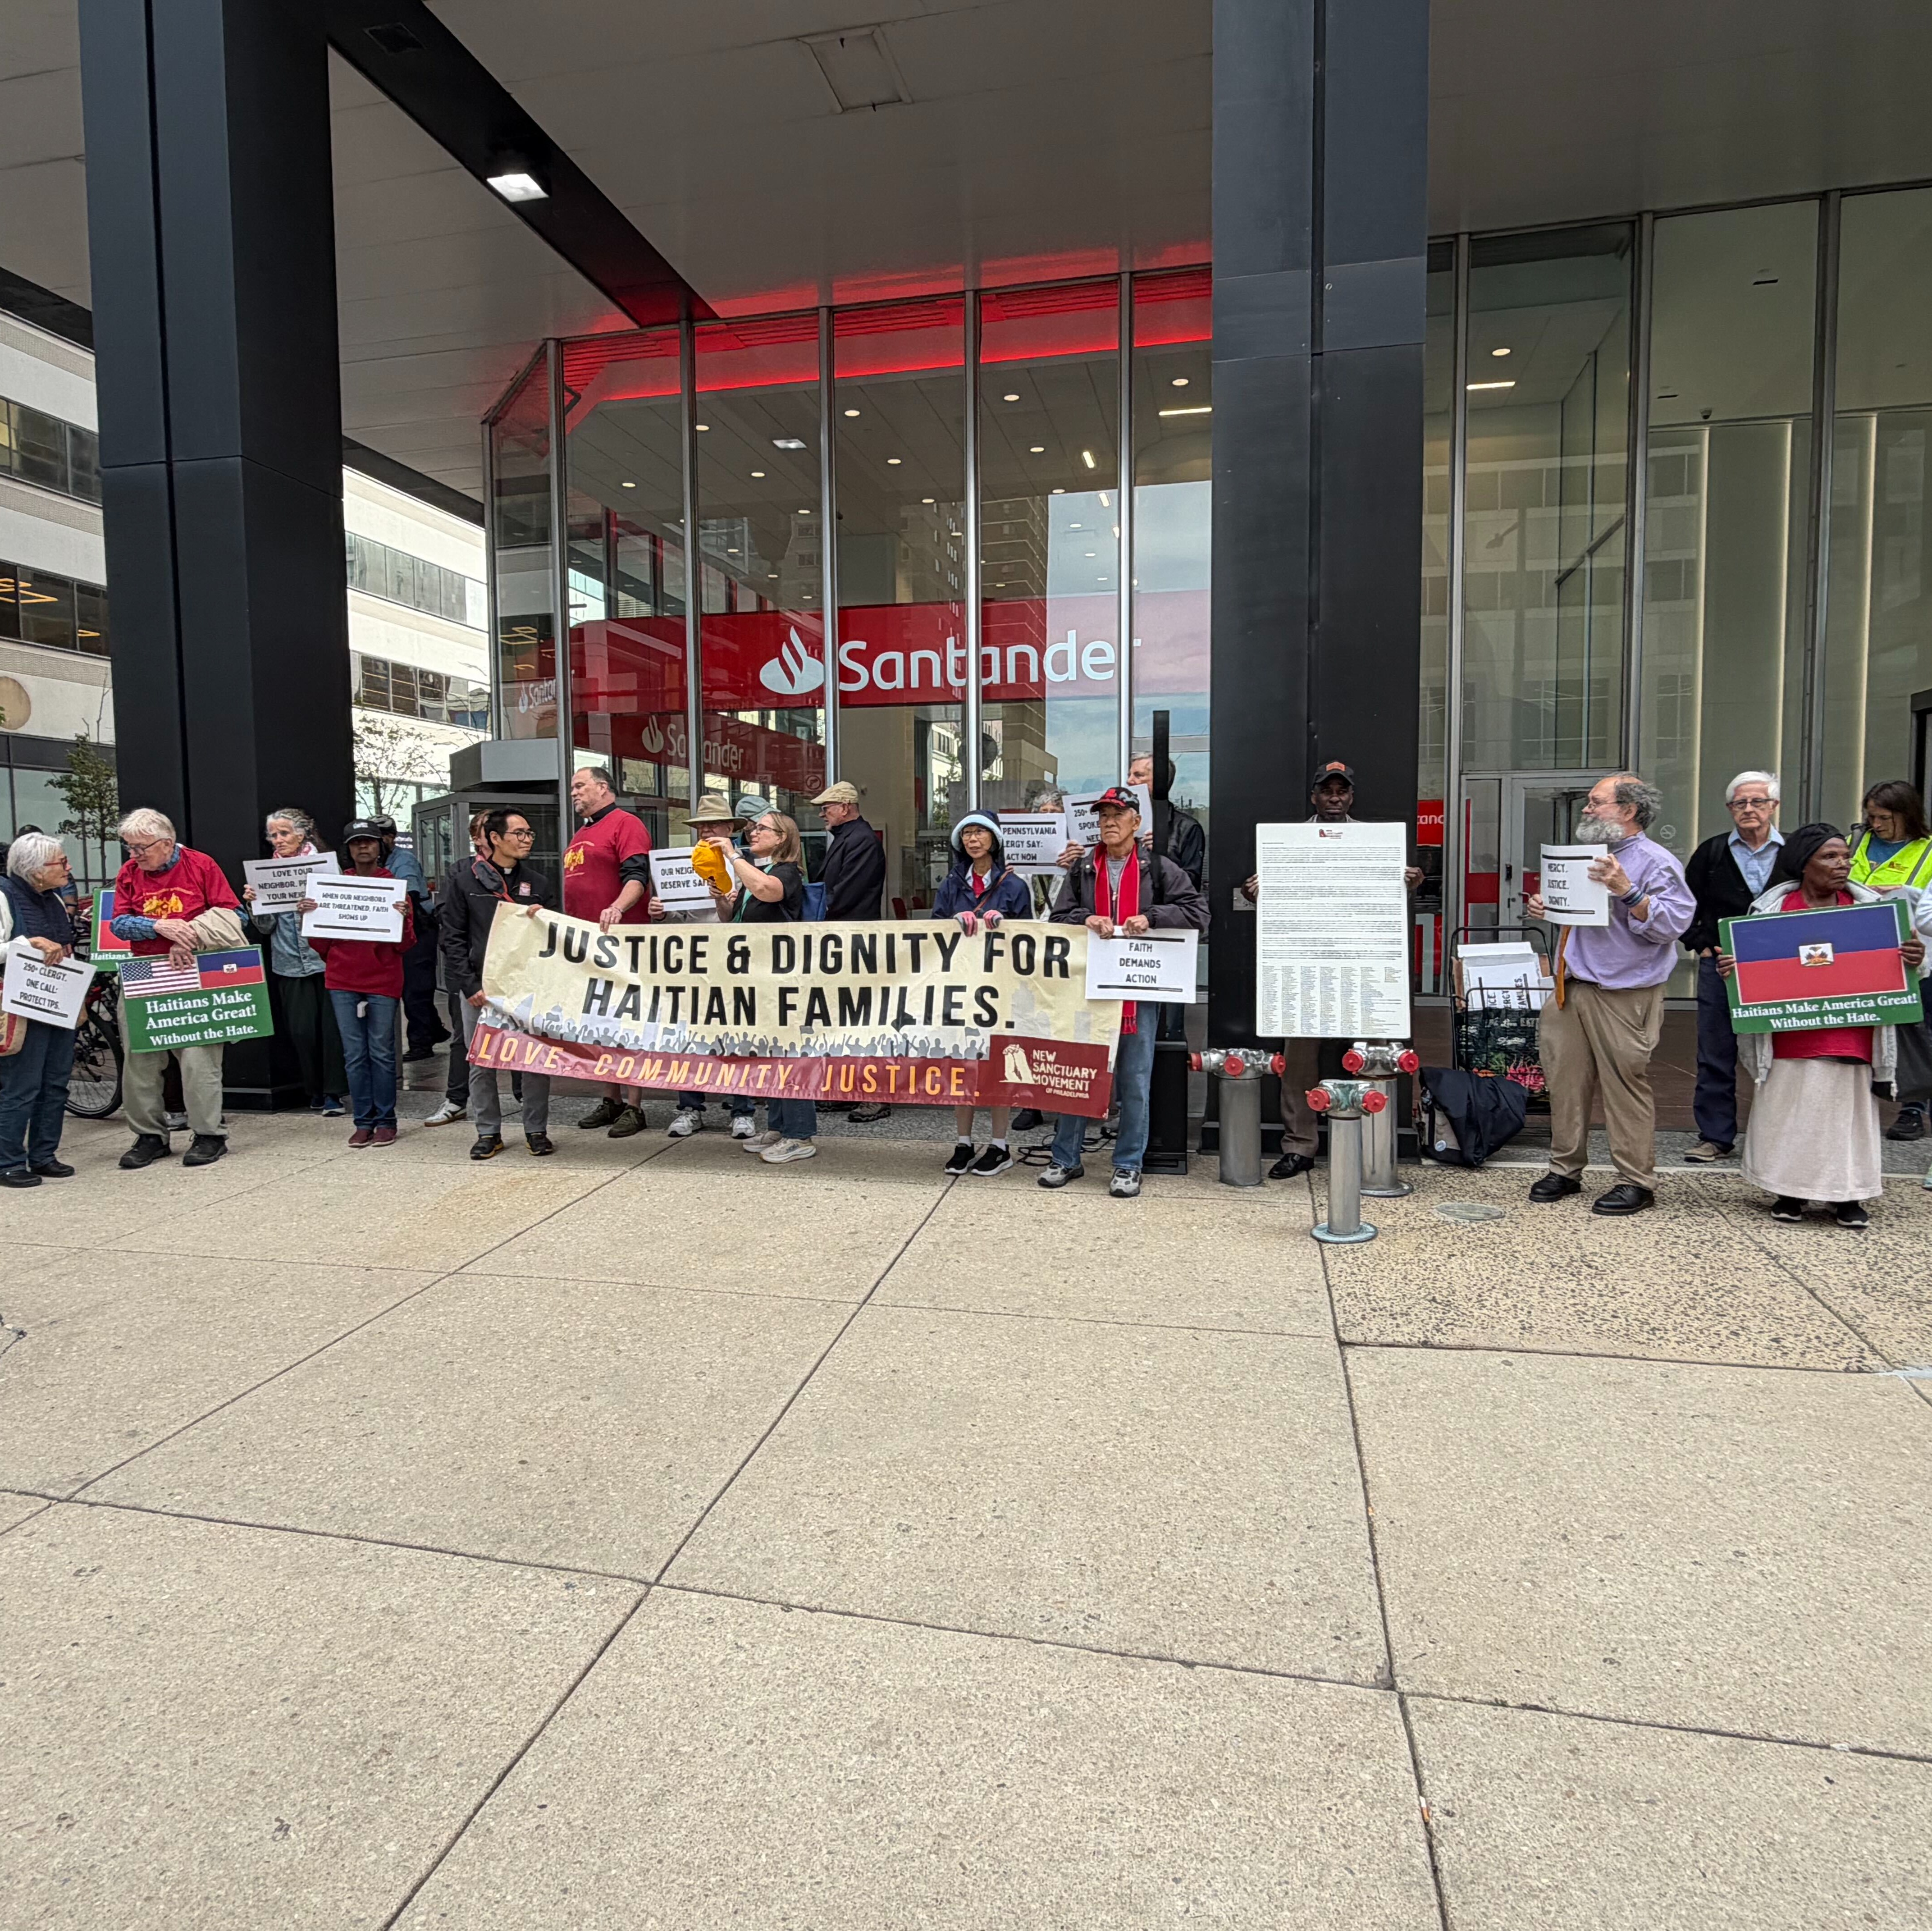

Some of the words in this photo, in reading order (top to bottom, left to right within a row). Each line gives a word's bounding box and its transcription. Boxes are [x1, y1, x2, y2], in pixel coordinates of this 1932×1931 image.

[839, 630, 1141, 691] Santande
[667, 723, 744, 770] Saander
[1086, 834, 1101, 842] NEE
[293, 867, 313, 875] YOUR
[661, 868, 674, 876] OUR
[258, 881, 297, 890] NEIGHBOR.
[661, 880, 690, 889] DESERVE
[267, 892, 287, 900] YOUR
[288, 890, 306, 898] NEIG
[353, 894, 386, 903] NEIGHBORS
[539, 921, 709, 974] JUSTICE
[726, 935, 751, 975] &
[772, 932, 962, 975] DIGNITY
[983, 931, 1071, 978] FOR
[1128, 942, 1153, 952] FAITH
[1119, 958, 1161, 968] DEMANDS
[26, 978, 40, 989] ONE
[1125, 974, 1156, 984] ACTION
[19, 991, 46, 1006] PROTECT
[47, 999, 60, 1010] TPS.
[145, 997, 209, 1014] Haitians
[212, 990, 252, 1006] Make
[582, 978, 755, 1026] HAITIAN
[778, 984, 1015, 1030] FAMILIES.
[1732, 1006, 1783, 1019] Haitians
[1785, 1001, 1819, 1014] Make
[1822, 997, 1876, 1011] America
[1877, 993, 1918, 1007] Great!
[146, 1012, 209, 1030] America
[212, 1004, 257, 1021] Great!
[1769, 1016, 1822, 1029] Without
[1823, 1014, 1845, 1025] the
[1847, 1012, 1881, 1023] Hate.
[150, 1031, 201, 1046] Without
[204, 1028, 224, 1039] the
[225, 1025, 258, 1037] Hate.
[1032, 1049, 1056, 1062] NEW
[1032, 1062, 1097, 1080] SANCTUARY
[821, 1064, 980, 1097] JUSTICE.
[1032, 1073, 1090, 1092] MOVEMENT
[1053, 1089, 1089, 1099] PHILADELPHIA
